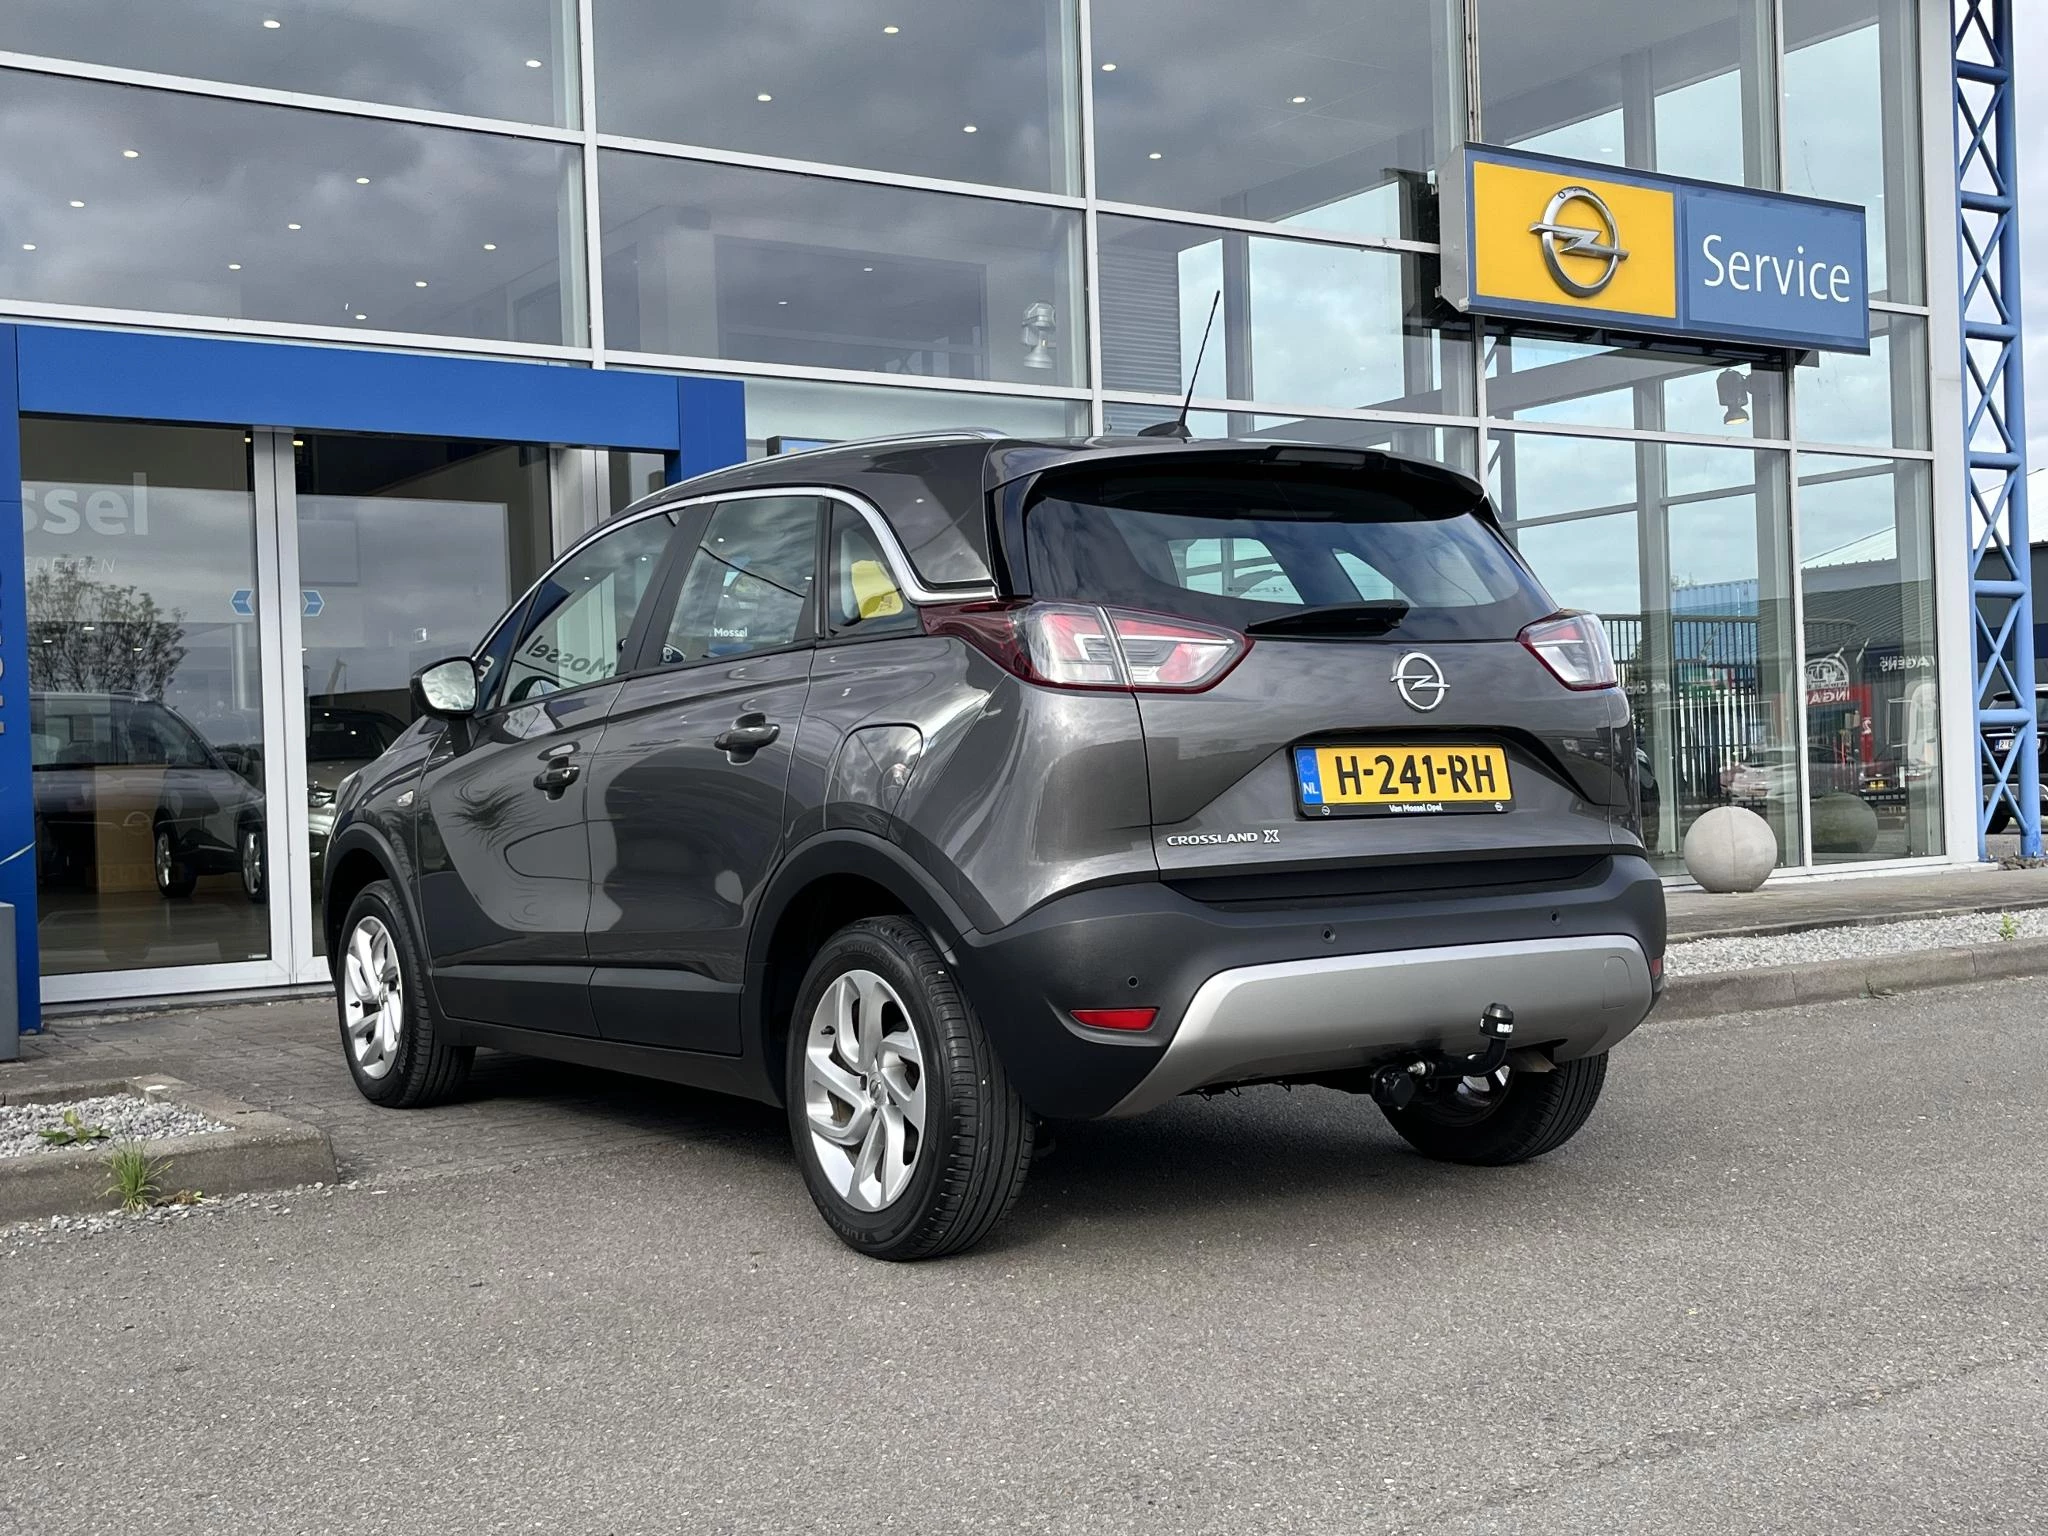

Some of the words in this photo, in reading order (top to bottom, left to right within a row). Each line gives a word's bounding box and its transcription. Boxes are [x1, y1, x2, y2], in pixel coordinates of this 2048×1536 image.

[1702, 234, 1850, 303] Service
[713, 626, 748, 638] Mossel
[1334, 754, 1496, 796] H-241-RH
[1303, 782, 1319, 795] NL
[1389, 804, 1402, 813] Van
[1403, 803, 1426, 812] Mossel
[1427, 802, 1443, 813] Opel
[1166, 831, 1258, 846] CROSSLAND
[1262, 829, 1281, 843] X
